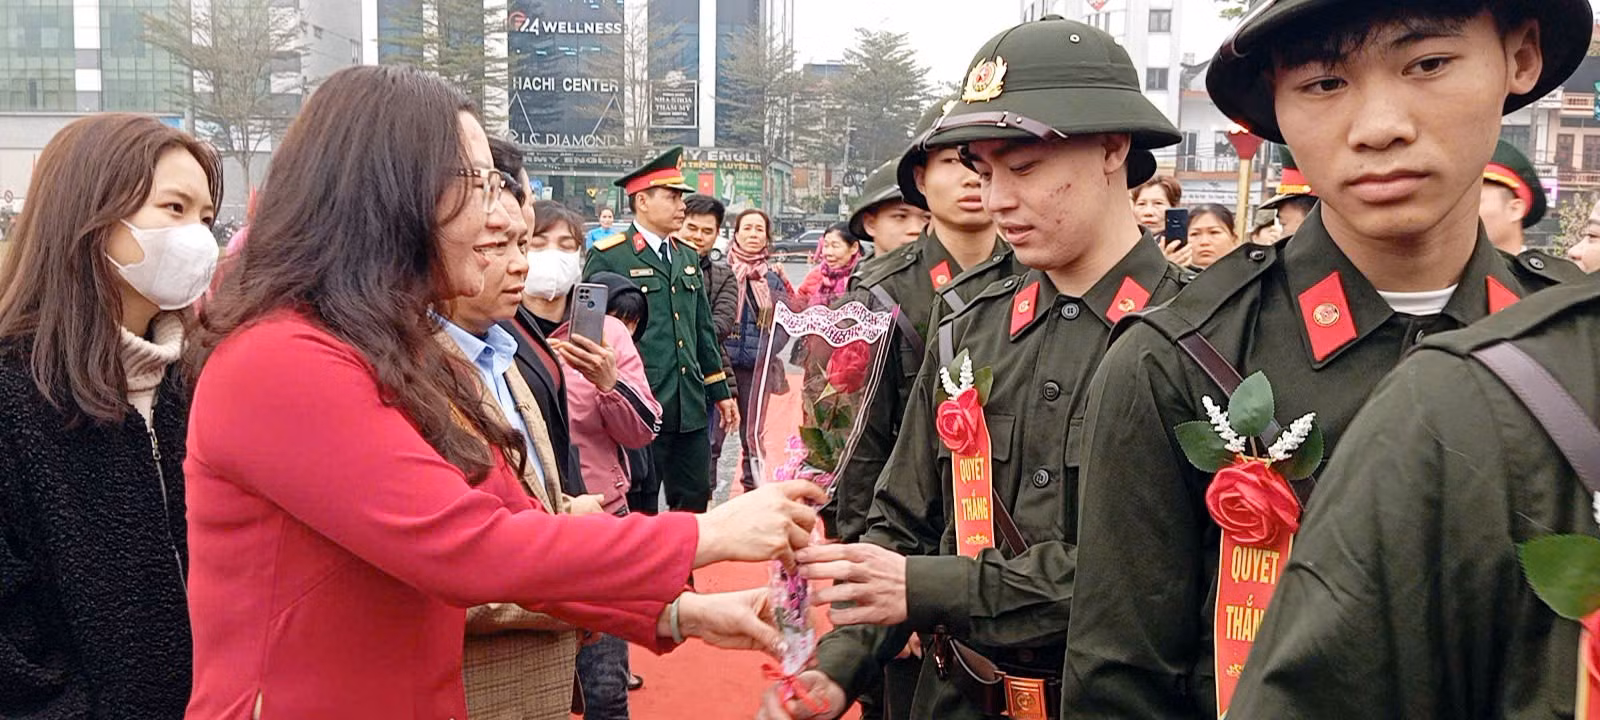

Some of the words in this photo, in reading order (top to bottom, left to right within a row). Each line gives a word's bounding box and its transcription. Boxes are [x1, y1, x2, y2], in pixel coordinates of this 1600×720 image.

[542, 21, 622, 34] WELLNESS
[513, 77, 555, 92] HACHI
[562, 77, 619, 92] CENTER
[545, 133, 619, 147] DIAMOND
[959, 450, 985, 484] QUYẾT
[961, 489, 989, 521] THẮNG
[1226, 594, 1265, 642] THẮN
